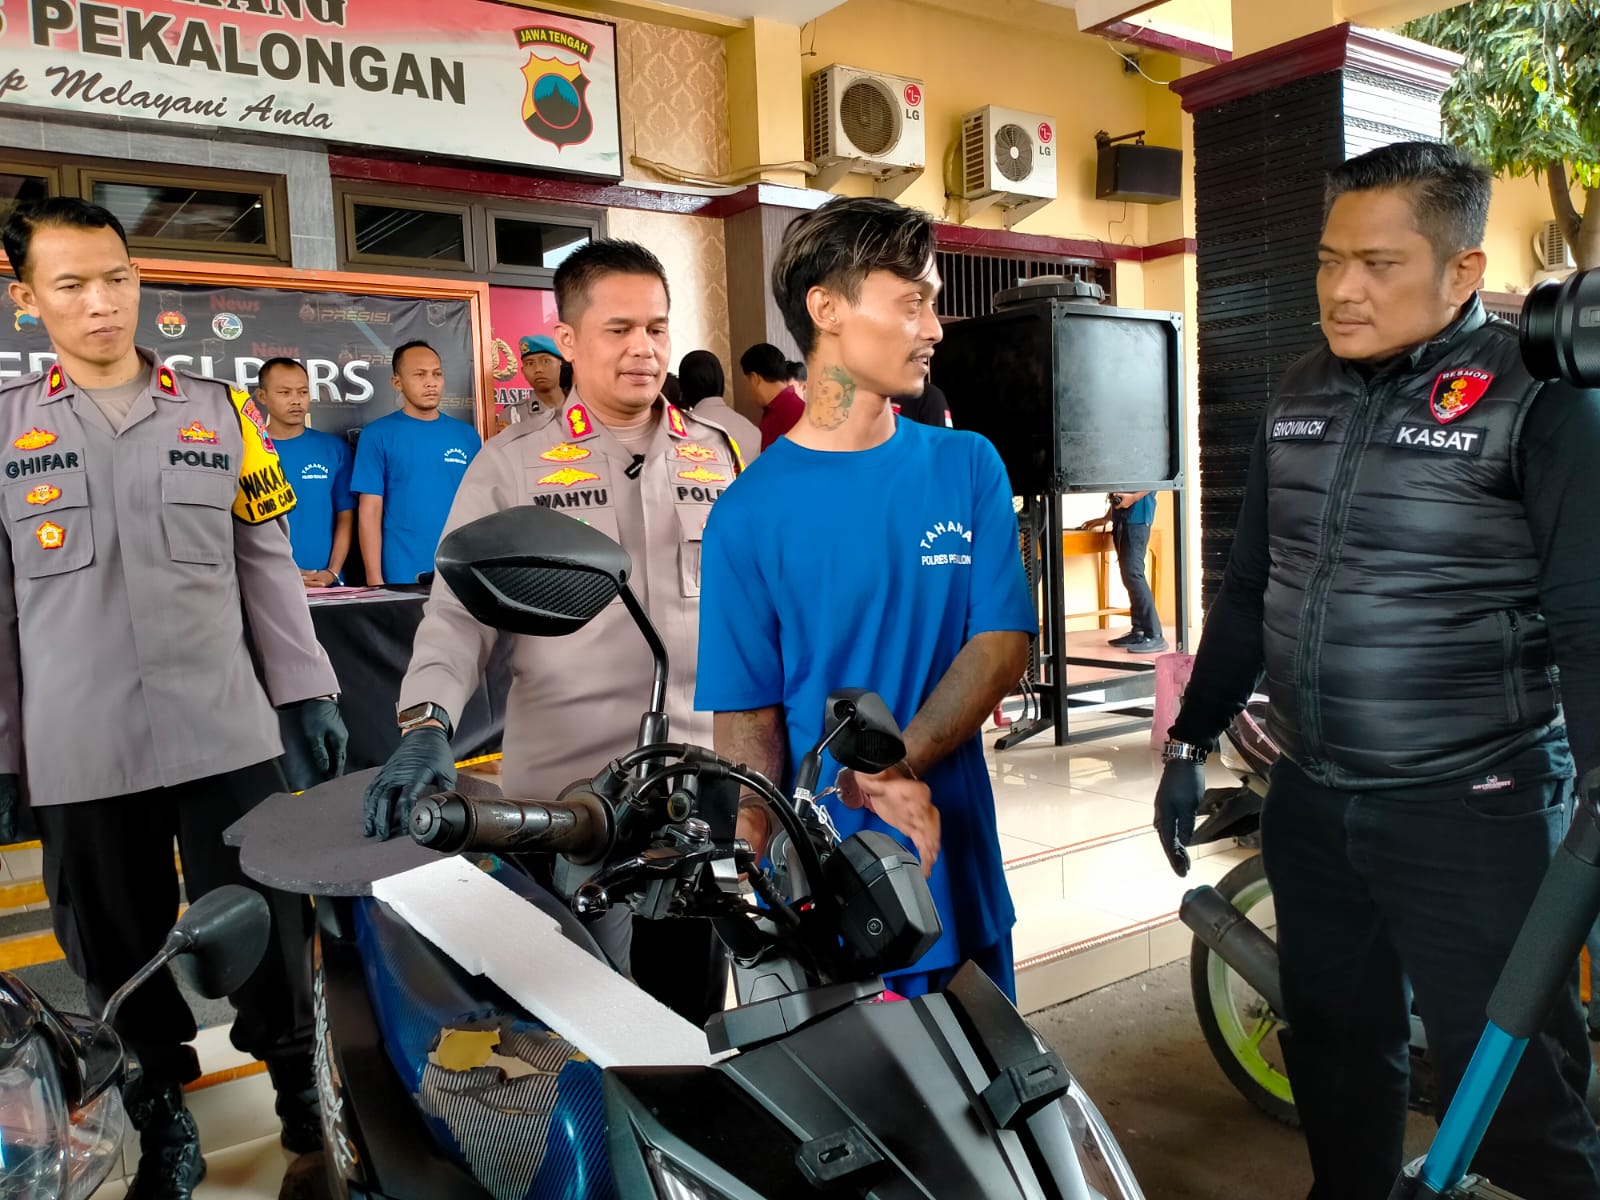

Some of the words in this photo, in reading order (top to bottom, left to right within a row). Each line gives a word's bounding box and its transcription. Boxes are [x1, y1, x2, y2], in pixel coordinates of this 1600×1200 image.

[32, 0, 466, 104] PEKALONGAN
[520, 28, 547, 43] JAWA
[549, 31, 588, 55] TENGAH
[45, 66, 228, 118] Melayani
[238, 94, 334, 130] Anda
[905, 108, 920, 121] LG
[1039, 145, 1051, 156] LG
[320, 309, 392, 323] PRESISI
[1442, 370, 1488, 380] RESMOB
[1396, 426, 1478, 451] KASAT
[5, 452, 79, 479] GHIFAR
[169, 449, 230, 471] POLRI
[533, 488, 608, 509] WAHYU
[676, 486, 725, 502] POL
[920, 520, 973, 549] TAHANA
[921, 553, 948, 566] POLRES
